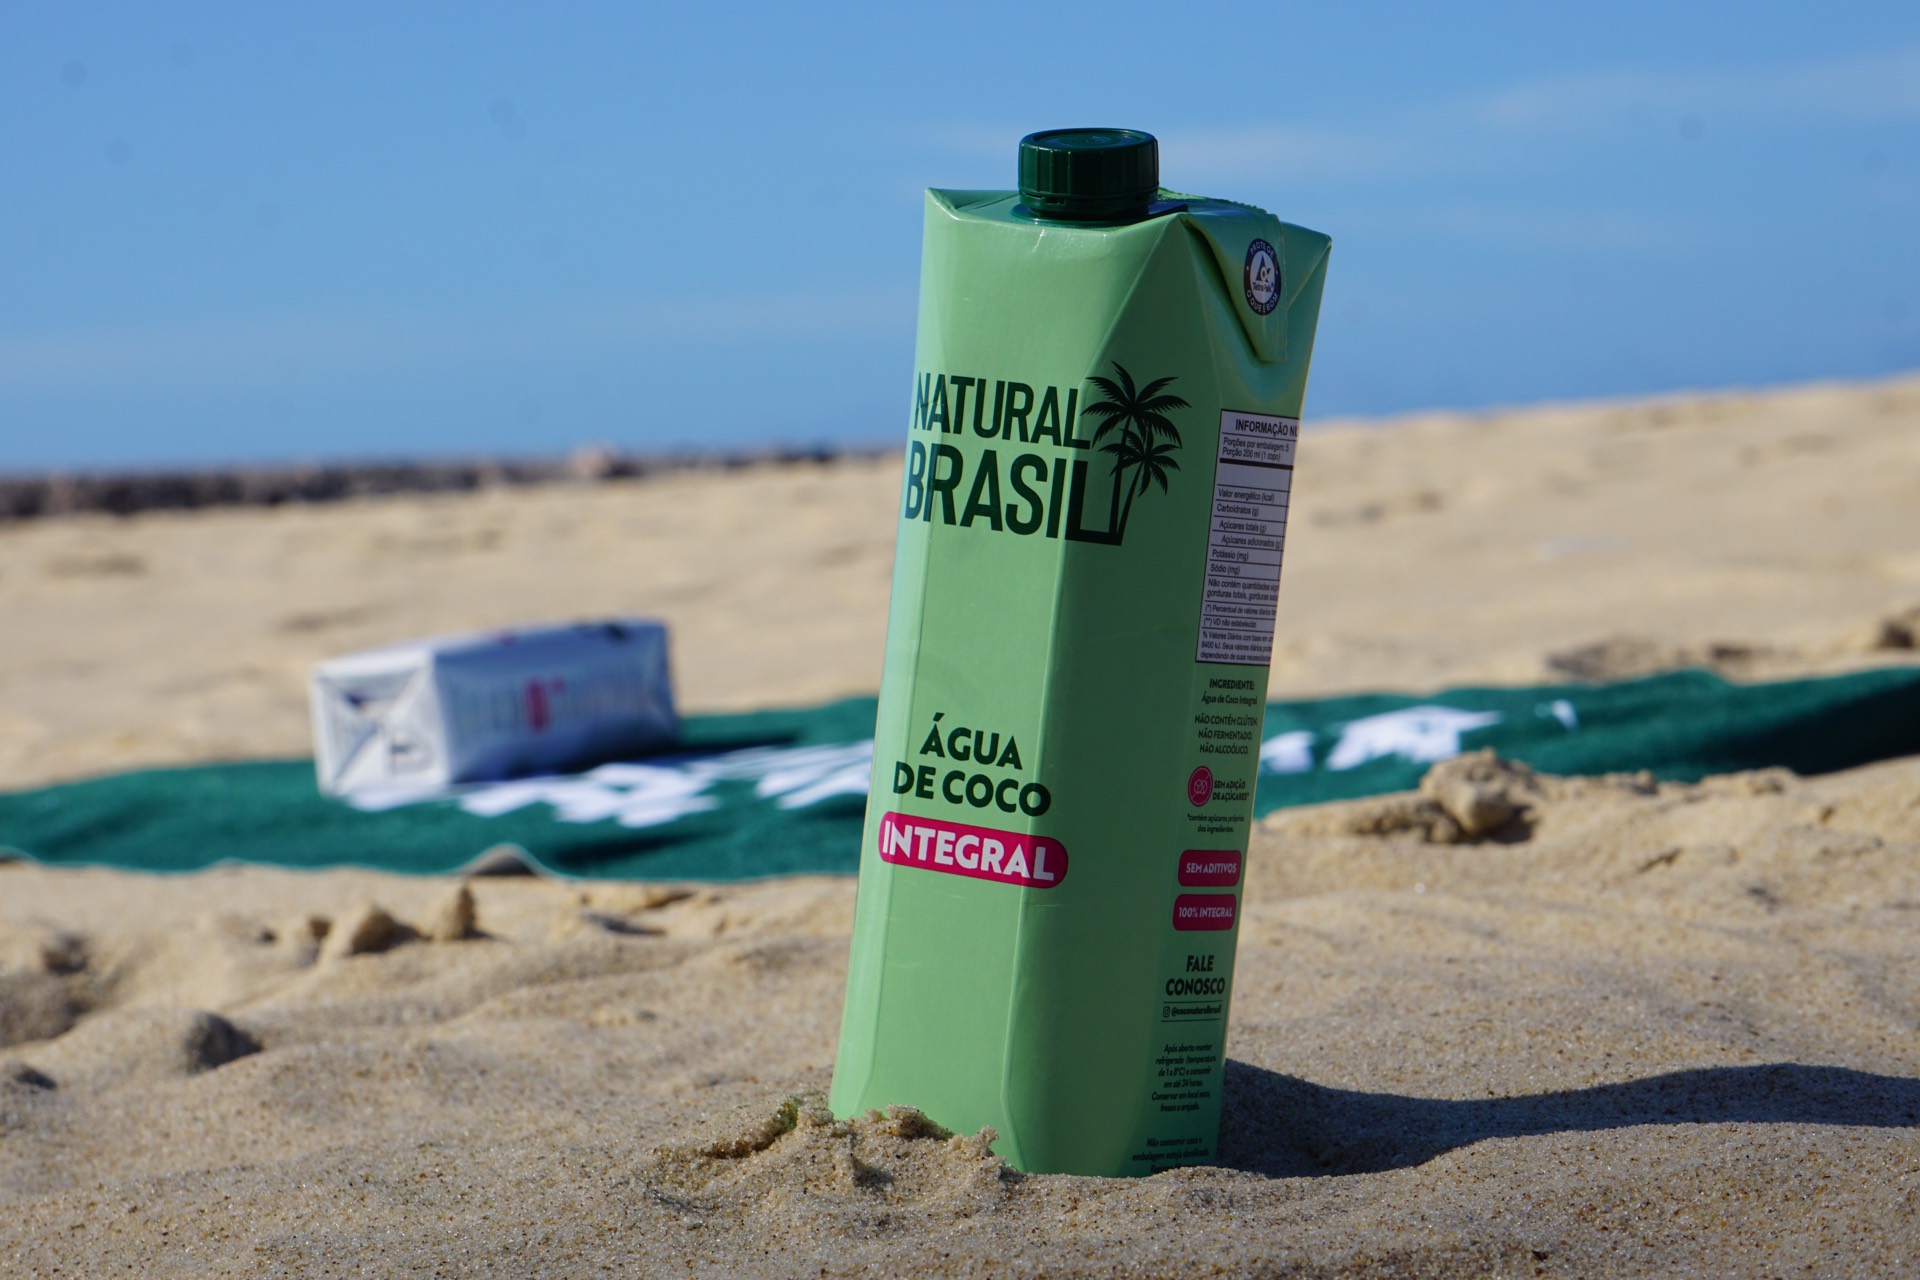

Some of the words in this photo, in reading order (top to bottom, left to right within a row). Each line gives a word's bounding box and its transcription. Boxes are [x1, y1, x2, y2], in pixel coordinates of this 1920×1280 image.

[1250, 241, 1274, 258] PROTEGE
[1247, 290, 1252, 298] O
[1250, 298, 1261, 313] QUE
[1266, 292, 1278, 311] BOM
[914, 371, 1090, 449] NATURAL
[1235, 418, 1288, 437] INFORMAÇÃO
[1224, 436, 1246, 448] Porções
[1246, 441, 1255, 449] por
[1223, 446, 1242, 457] Porção
[1243, 449, 1253, 458] 200
[1254, 450, 1260, 458] ml
[905, 440, 1122, 546] BRASIL
[1218, 488, 1233, 498] Valor
[1234, 491, 1261, 501] energético
[1262, 493, 1274, 502] (kcal)
[1217, 504, 1251, 514] Carboidratos
[1219, 520, 1244, 530] Açúcares
[1246, 522, 1259, 531] totais
[1221, 535, 1247, 546] Açúcares
[1248, 538, 1274, 548] adicionados
[1212, 549, 1235, 558] Potássio
[1237, 552, 1249, 562] (mg)
[1211, 564, 1226, 572] Sódio
[1228, 565, 1240, 574] (mg)
[1208, 579, 1220, 587] Não
[1221, 580, 1240, 588] contém
[1242, 582, 1270, 590] quantidades
[1207, 590, 1231, 598] gorduras
[1248, 593, 1268, 601] gorduras
[1212, 605, 1237, 614] Percentual
[1222, 618, 1230, 626] não
[1231, 620, 1256, 628] estabelecido
[1208, 631, 1226, 639] Valores
[1227, 632, 1242, 640] Diários
[1222, 642, 1233, 650] Seus
[1201, 651, 1229, 660] dependendo
[1210, 678, 1255, 691] INGREDIENTE:
[1201, 690, 1216, 705] Água
[1217, 694, 1224, 703] de
[1226, 695, 1238, 704] Coco
[1240, 696, 1257, 707] Integral
[1195, 712, 1209, 724] NÃO
[1211, 714, 1235, 725] CONTÉM
[1198, 728, 1213, 739] NÃO
[920, 712, 1022, 770] ÁGUA
[1200, 742, 1214, 753] NÃO
[893, 761, 936, 799] DE
[942, 770, 1051, 816] COCO
[1214, 780, 1226, 789] SEM
[1226, 779, 1246, 790] ADIÇÃO
[1213, 792, 1220, 800] DE
[1208, 815, 1227, 823] açúcares
[882, 821, 1054, 881] INTEGRAL
[1186, 862, 1201, 873] SEM
[1203, 863, 1236, 874] ADITIVOS
[1179, 907, 1198, 918] 100%
[1200, 907, 1232, 918] INTEGRAL
[1186, 954, 1215, 972] FALE
[1166, 977, 1226, 996] CONOSCO
[1164, 1044, 1178, 1054] Após
[1156, 1056, 1184, 1066] refrigerado
[1158, 1068, 1165, 1076] de
[1152, 1092, 1178, 1100] Conservar
[1161, 1103, 1176, 1112] fresco
[1132, 1152, 1165, 1162] embalagem
